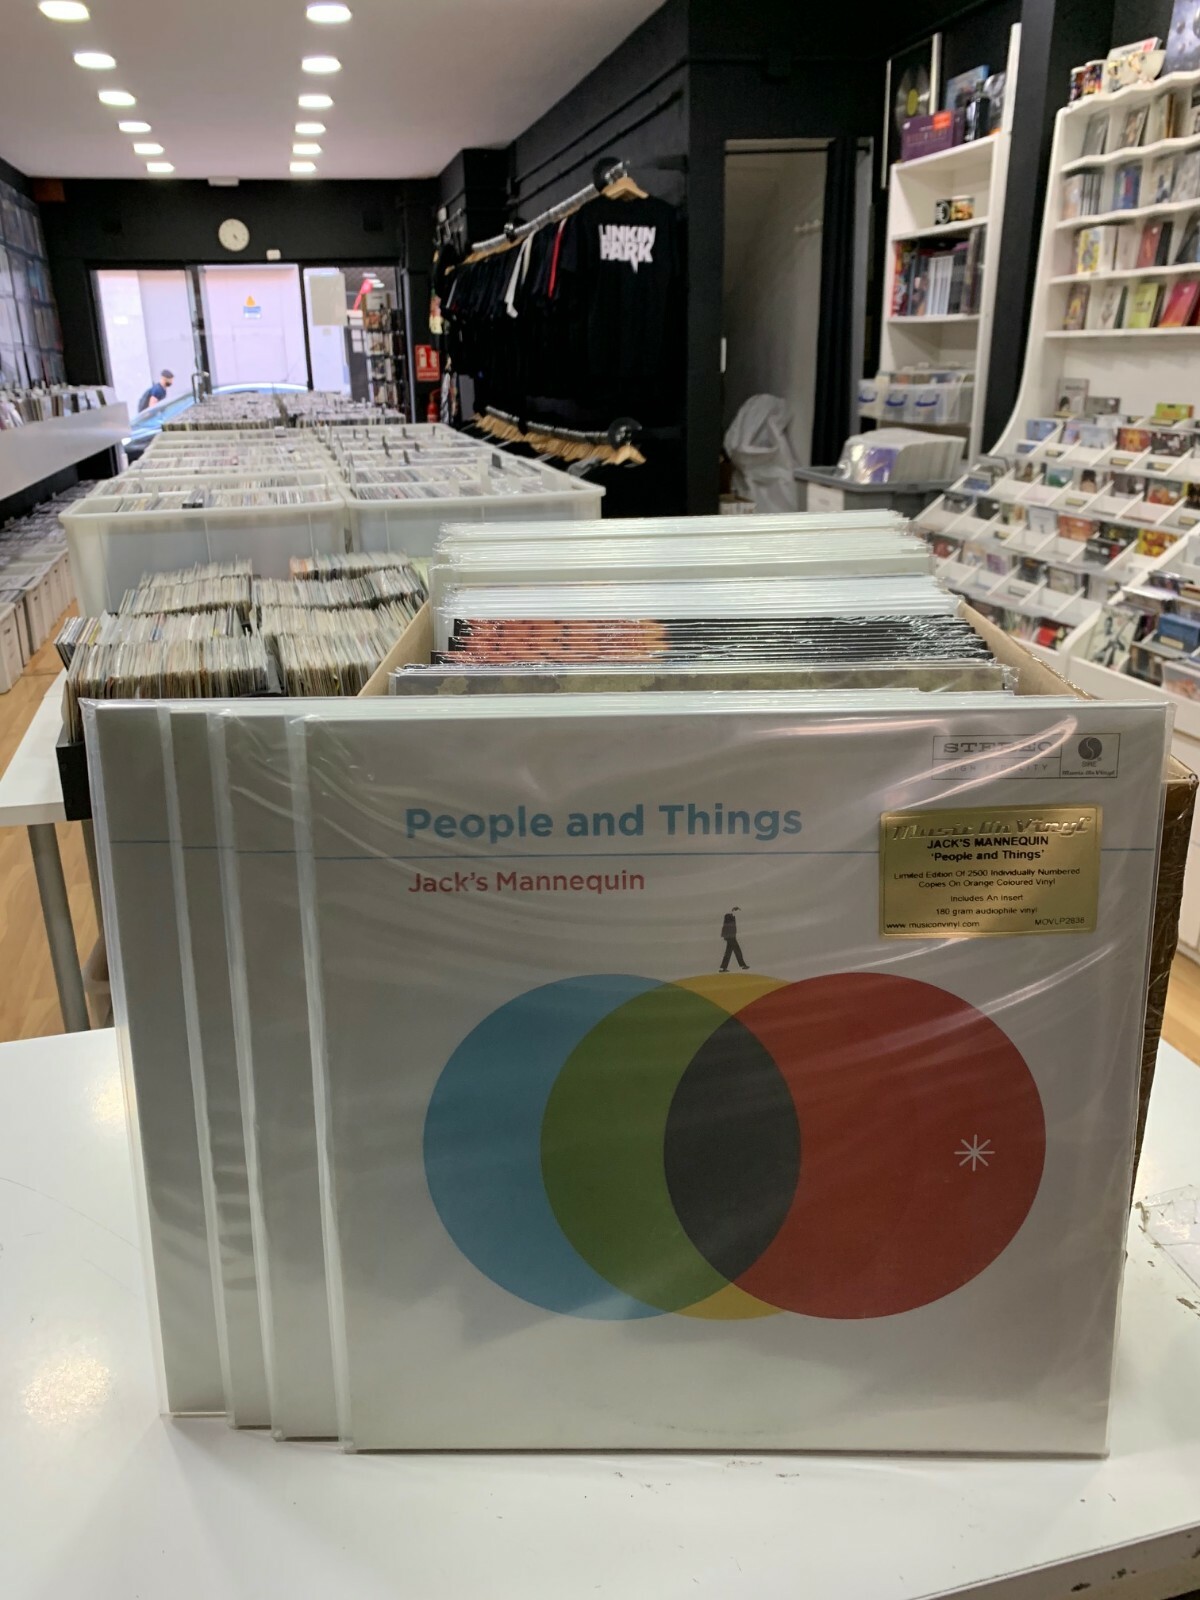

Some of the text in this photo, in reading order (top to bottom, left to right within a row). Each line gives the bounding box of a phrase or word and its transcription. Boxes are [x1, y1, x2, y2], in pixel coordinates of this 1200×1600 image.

[598, 224, 656, 243] LINKIN
[600, 242, 653, 273] PARK
[405, 803, 803, 844] People and Things
[893, 822, 975, 840] Music
[978, 821, 1012, 836] On
[927, 836, 1049, 849] JACK'S MANNEQUIN
[976, 850, 998, 860] and
[894, 867, 1081, 879] Limited Edition Of 2500 Individually Numbered
[408, 869, 645, 894] Jack's Mannequin
[918, 878, 1056, 889] Copies On Orange Coloured Vinyl
[950, 894, 984, 902] Includes
[986, 894, 999, 902] An
[936, 906, 1038, 917] 180 gram audiophile vinyl
